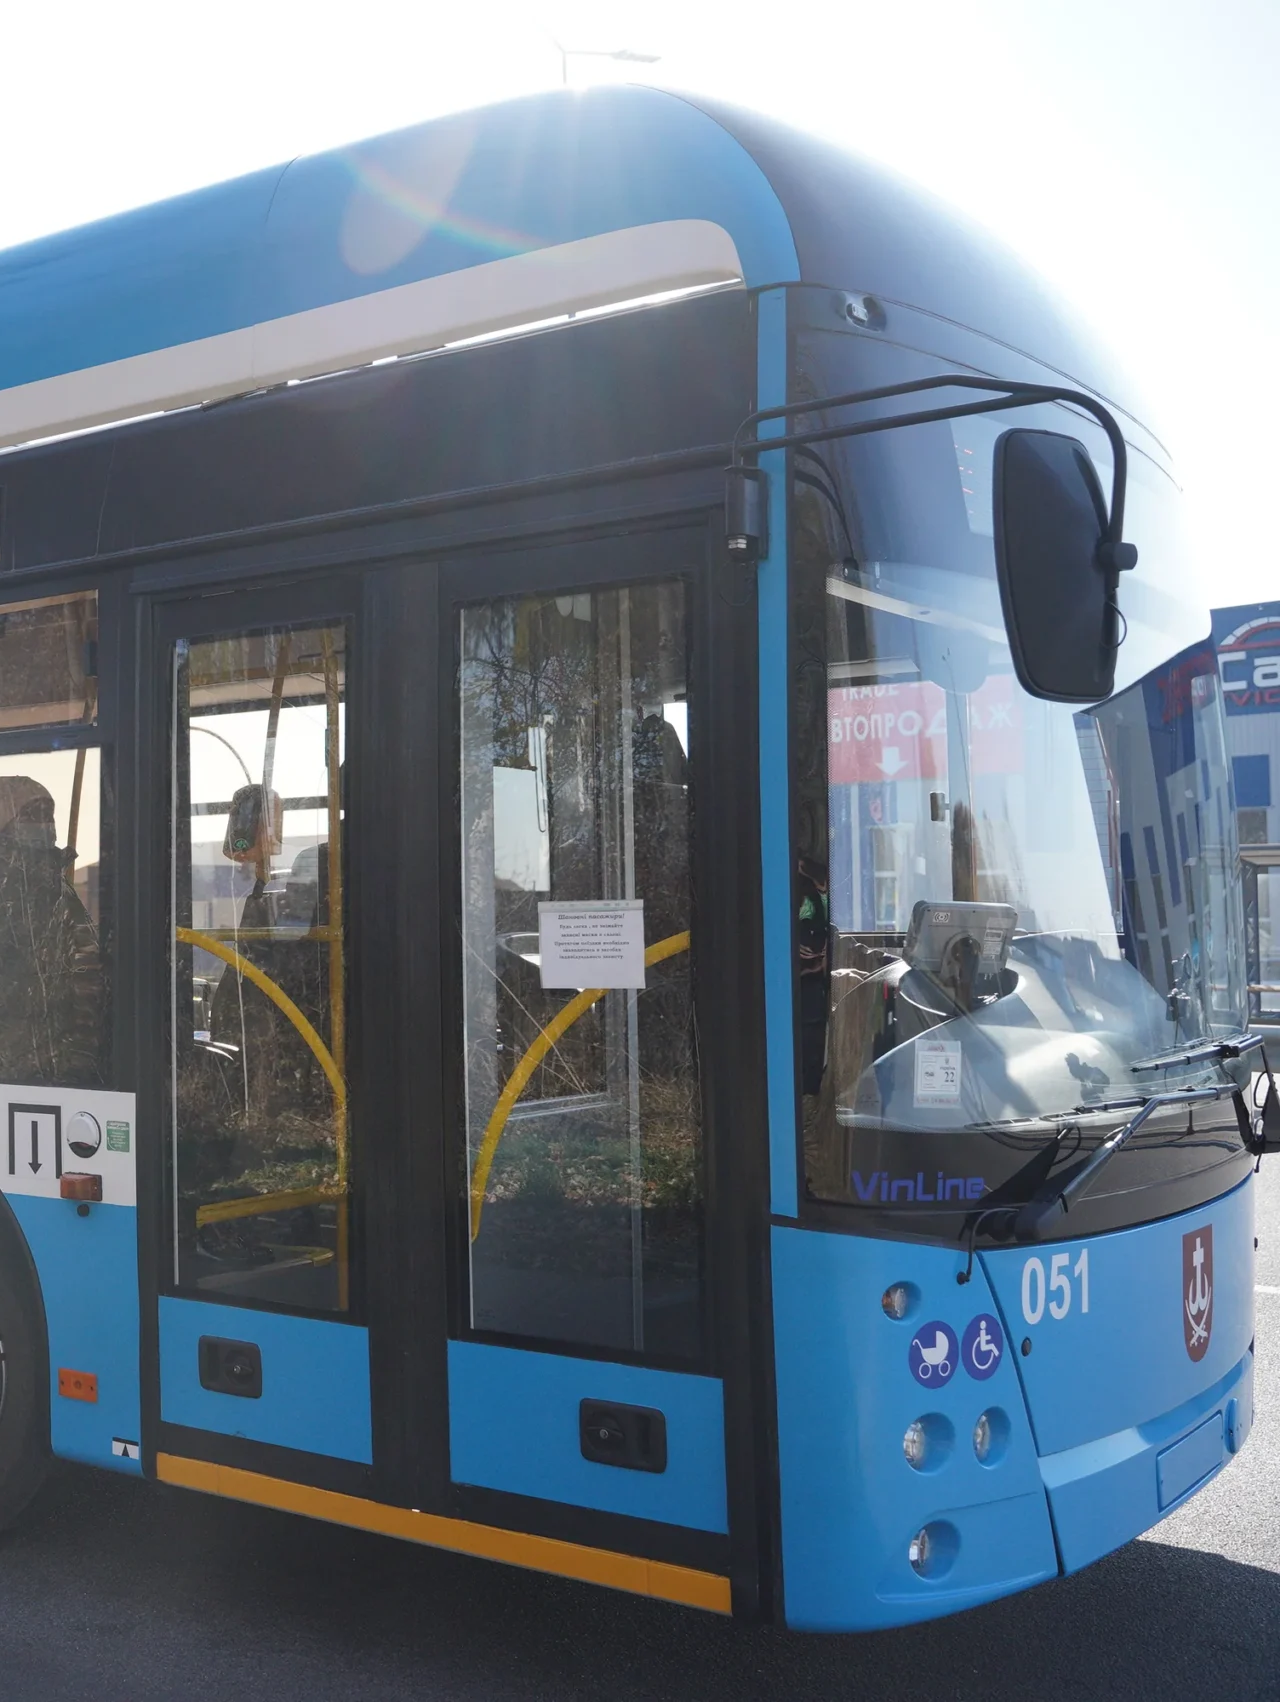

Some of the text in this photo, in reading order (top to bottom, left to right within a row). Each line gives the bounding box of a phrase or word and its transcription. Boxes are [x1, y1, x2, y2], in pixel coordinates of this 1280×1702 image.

[1223, 688, 1280, 706] VIC
[944, 1071, 955, 1083] 22
[851, 1169, 985, 1202] VinLine
[1021, 1248, 1089, 1325] 051
